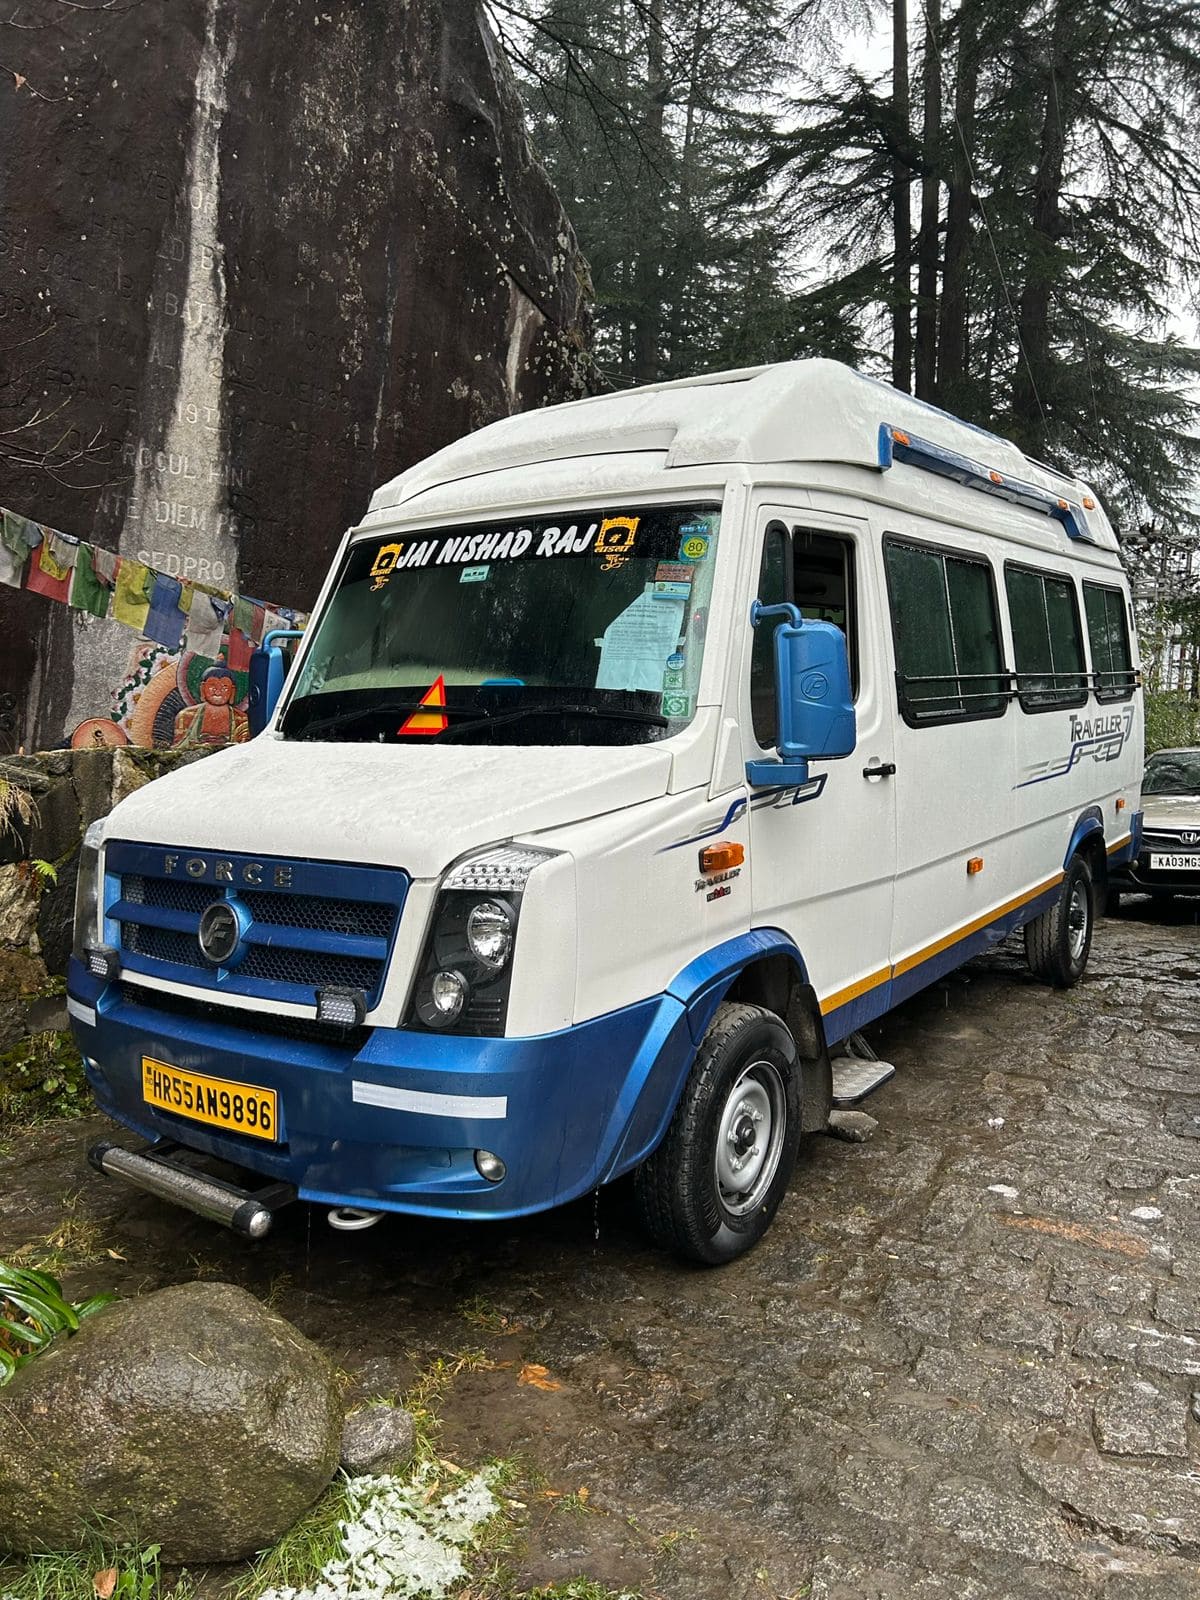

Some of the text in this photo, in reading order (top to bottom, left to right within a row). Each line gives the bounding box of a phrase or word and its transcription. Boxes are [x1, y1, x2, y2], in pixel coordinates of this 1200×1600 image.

[155, 500, 207, 531] DIEM
[396, 523, 598, 569] JAI NISHAD RAJ
[688, 542, 703, 552] 80
[1069, 714, 1122, 742] TRAVELLER
[163, 853, 294, 888] FORCE
[153, 1069, 271, 1130] HR55AN9896
